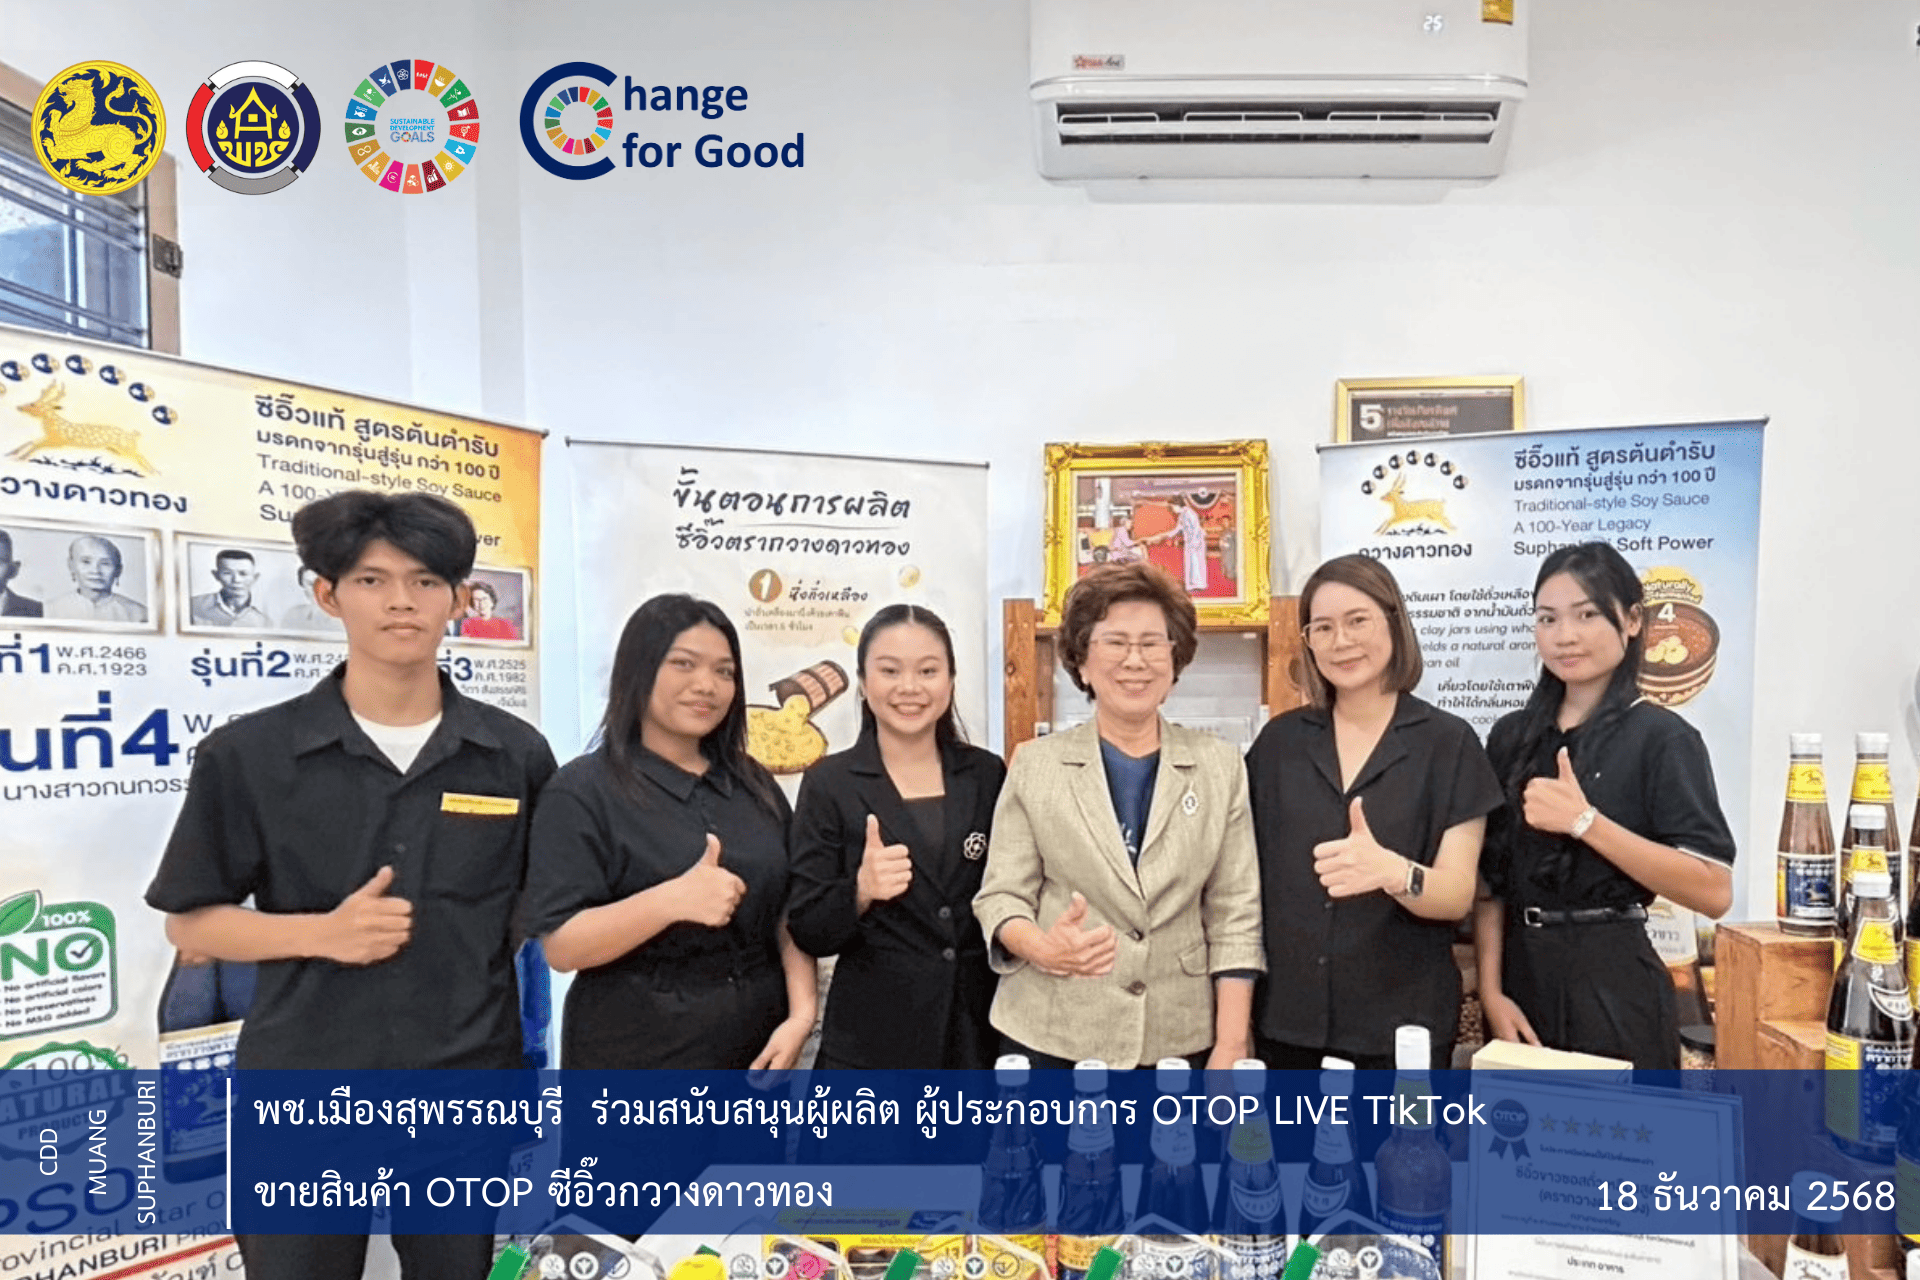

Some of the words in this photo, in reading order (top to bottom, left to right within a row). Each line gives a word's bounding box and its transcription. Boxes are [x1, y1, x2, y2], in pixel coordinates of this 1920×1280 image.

[1423, 14, 1443, 31] 25
[255, 393, 345, 431] ซีอิ๊วแท้
[354, 418, 499, 458] สูตรต้นตำรับ
[1359, 404, 1384, 431] 5
[256, 429, 413, 469] มรดกจากรุ่นสู่รุ่น
[417, 454, 449, 473] กว่า
[455, 461, 485, 478] 100
[489, 464, 501, 480] ปี
[1514, 444, 1580, 470] ซีอิ๊วแท้
[1586, 440, 1716, 472] สูตรต้นตำรับ
[256, 453, 413, 490] Traditional-style
[416, 477, 449, 496] Soy
[452, 483, 502, 503] Sauce
[258, 480, 275, 496] A
[1514, 470, 1633, 492] มรดกจากรุ่นสู่รุ่น
[1637, 469, 1667, 485] กว่า
[1672, 470, 1701, 483] 100
[1704, 466, 1716, 482] ปี
[673, 466, 911, 518] ขั้นตอนการผลิต
[1514, 495, 1627, 514] Traditional-style
[1630, 493, 1659, 510] Soy
[1662, 492, 1710, 507] Sauce
[675, 517, 910, 556] ซีอิ๊วตรากวางดาวทอง
[1513, 520, 1525, 534] A
[1529, 519, 1594, 534] 100-Year
[1597, 518, 1652, 533] Legacy
[1616, 536, 1653, 552] Soft
[1657, 536, 1715, 551] Power
[760, 571, 772, 600] 1
[789, 579, 869, 602] นึ่งถั่วเหลือง
[1658, 602, 1677, 623] 4
[1420, 625, 1446, 636] clay
[1447, 625, 1471, 637] jars
[1474, 623, 1508, 636] using
[57, 645, 147, 660] พ.ศ.2466
[1422, 640, 1447, 652] elds
[1450, 643, 1459, 652] a
[1462, 639, 1505, 652] natural
[57, 662, 147, 677] ค.ศ.1923
[191, 641, 291, 687] รุ่นที่2
[1444, 657, 1460, 669] oil
[474, 671, 527, 683] ค.ศ.1982
[41, 910, 92, 927] 100%
[1, 932, 104, 982] NO
[4, 984, 21, 992] No
[24, 976, 68, 989] artificial
[71, 971, 106, 982] flavors
[4, 996, 21, 1004] No
[25, 988, 68, 1001] artificial
[72, 983, 103, 994] colors
[5, 1008, 21, 1016] No
[25, 996, 96, 1014] preservatives
[5, 1020, 22, 1028] No
[26, 1013, 52, 1024] MSG
[56, 1007, 91, 1019] added
[1493, 1109, 1527, 1121] OTOP
